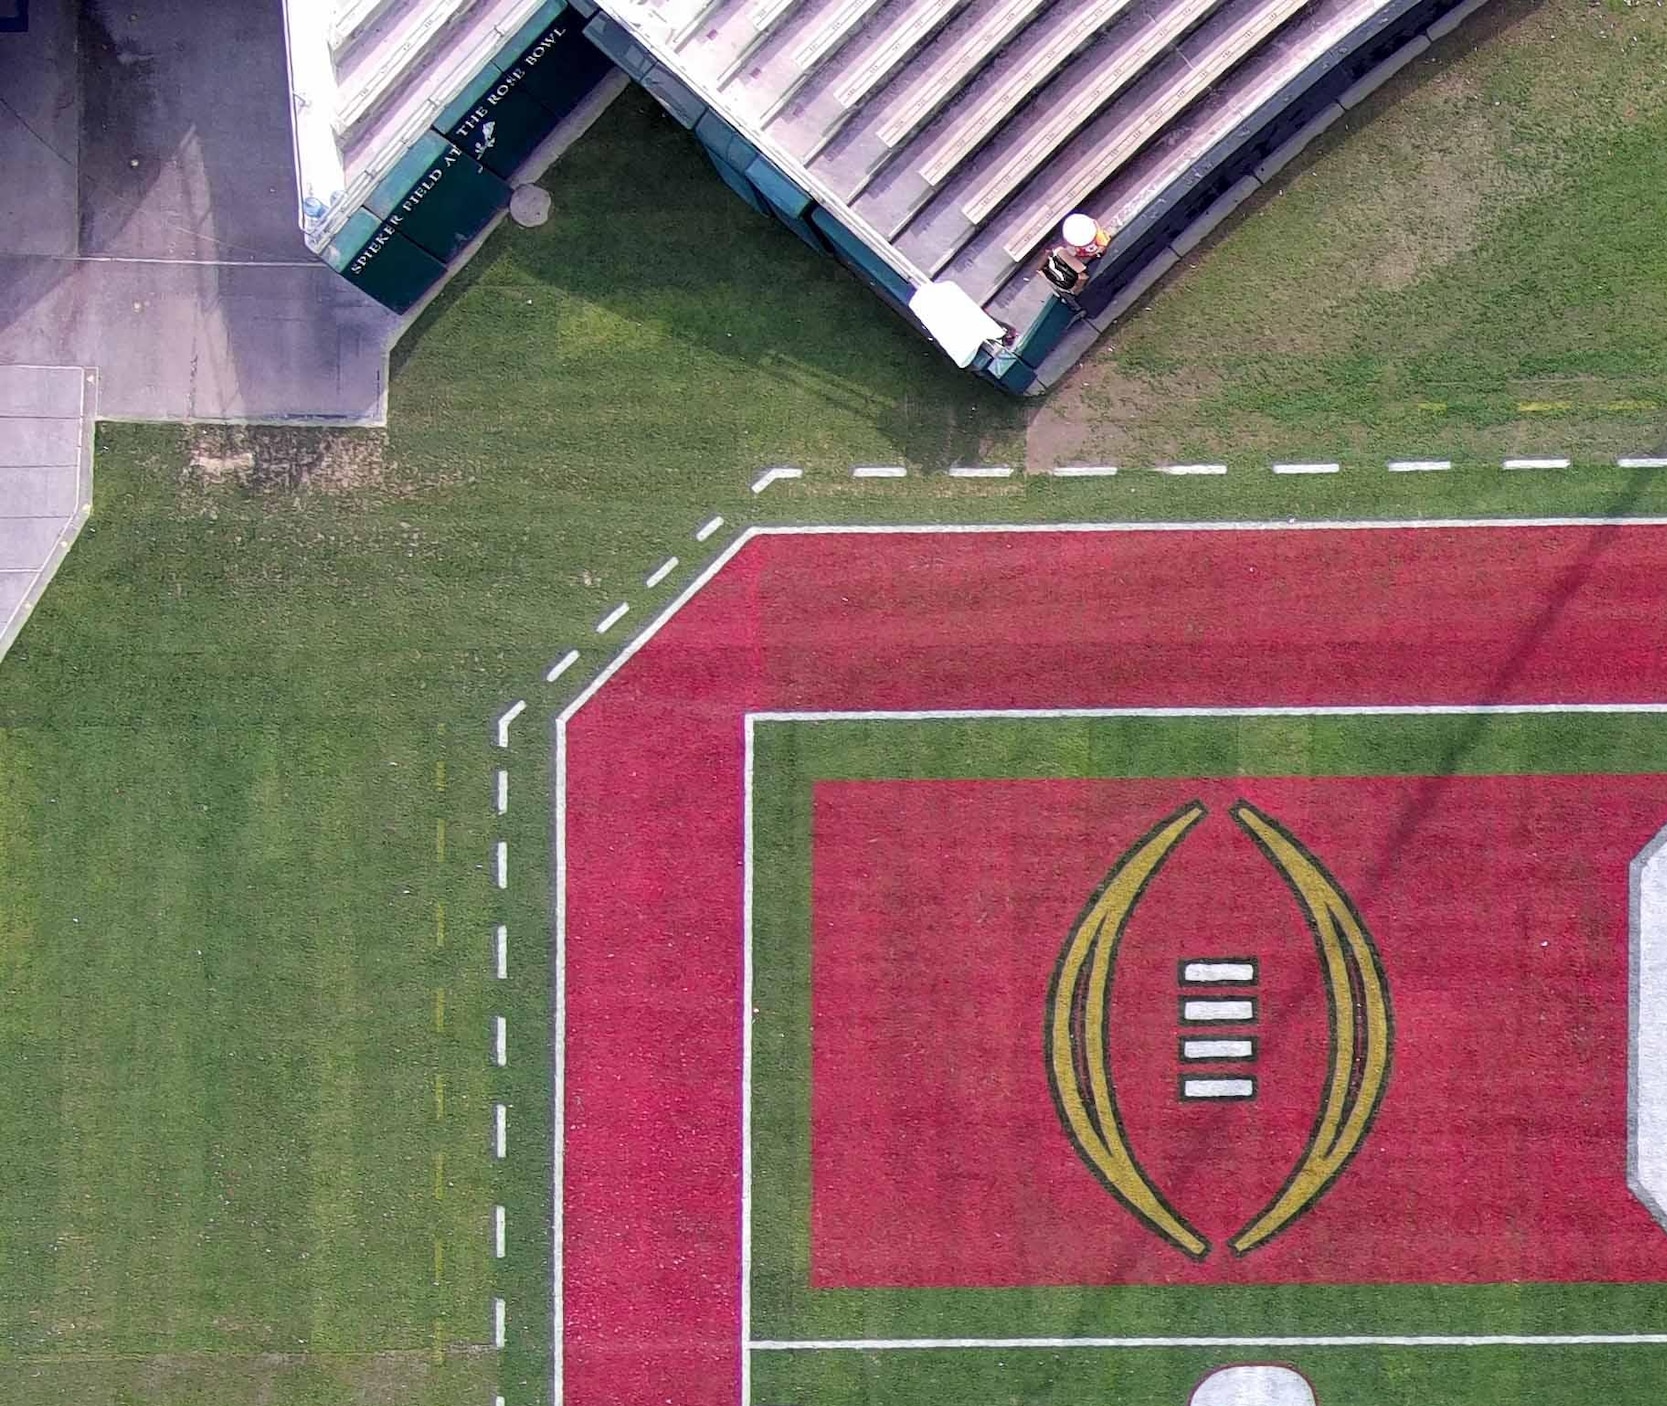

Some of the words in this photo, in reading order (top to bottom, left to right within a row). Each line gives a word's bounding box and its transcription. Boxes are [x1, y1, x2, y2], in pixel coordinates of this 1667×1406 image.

[351, 214, 404, 275] SPIEKER
[402, 168, 443, 212] FIELD
[444, 144, 463, 168] AT
[456, 106, 489, 137] THE
[487, 67, 526, 106] ROSE
[524, 26, 567, 66] BOWL
